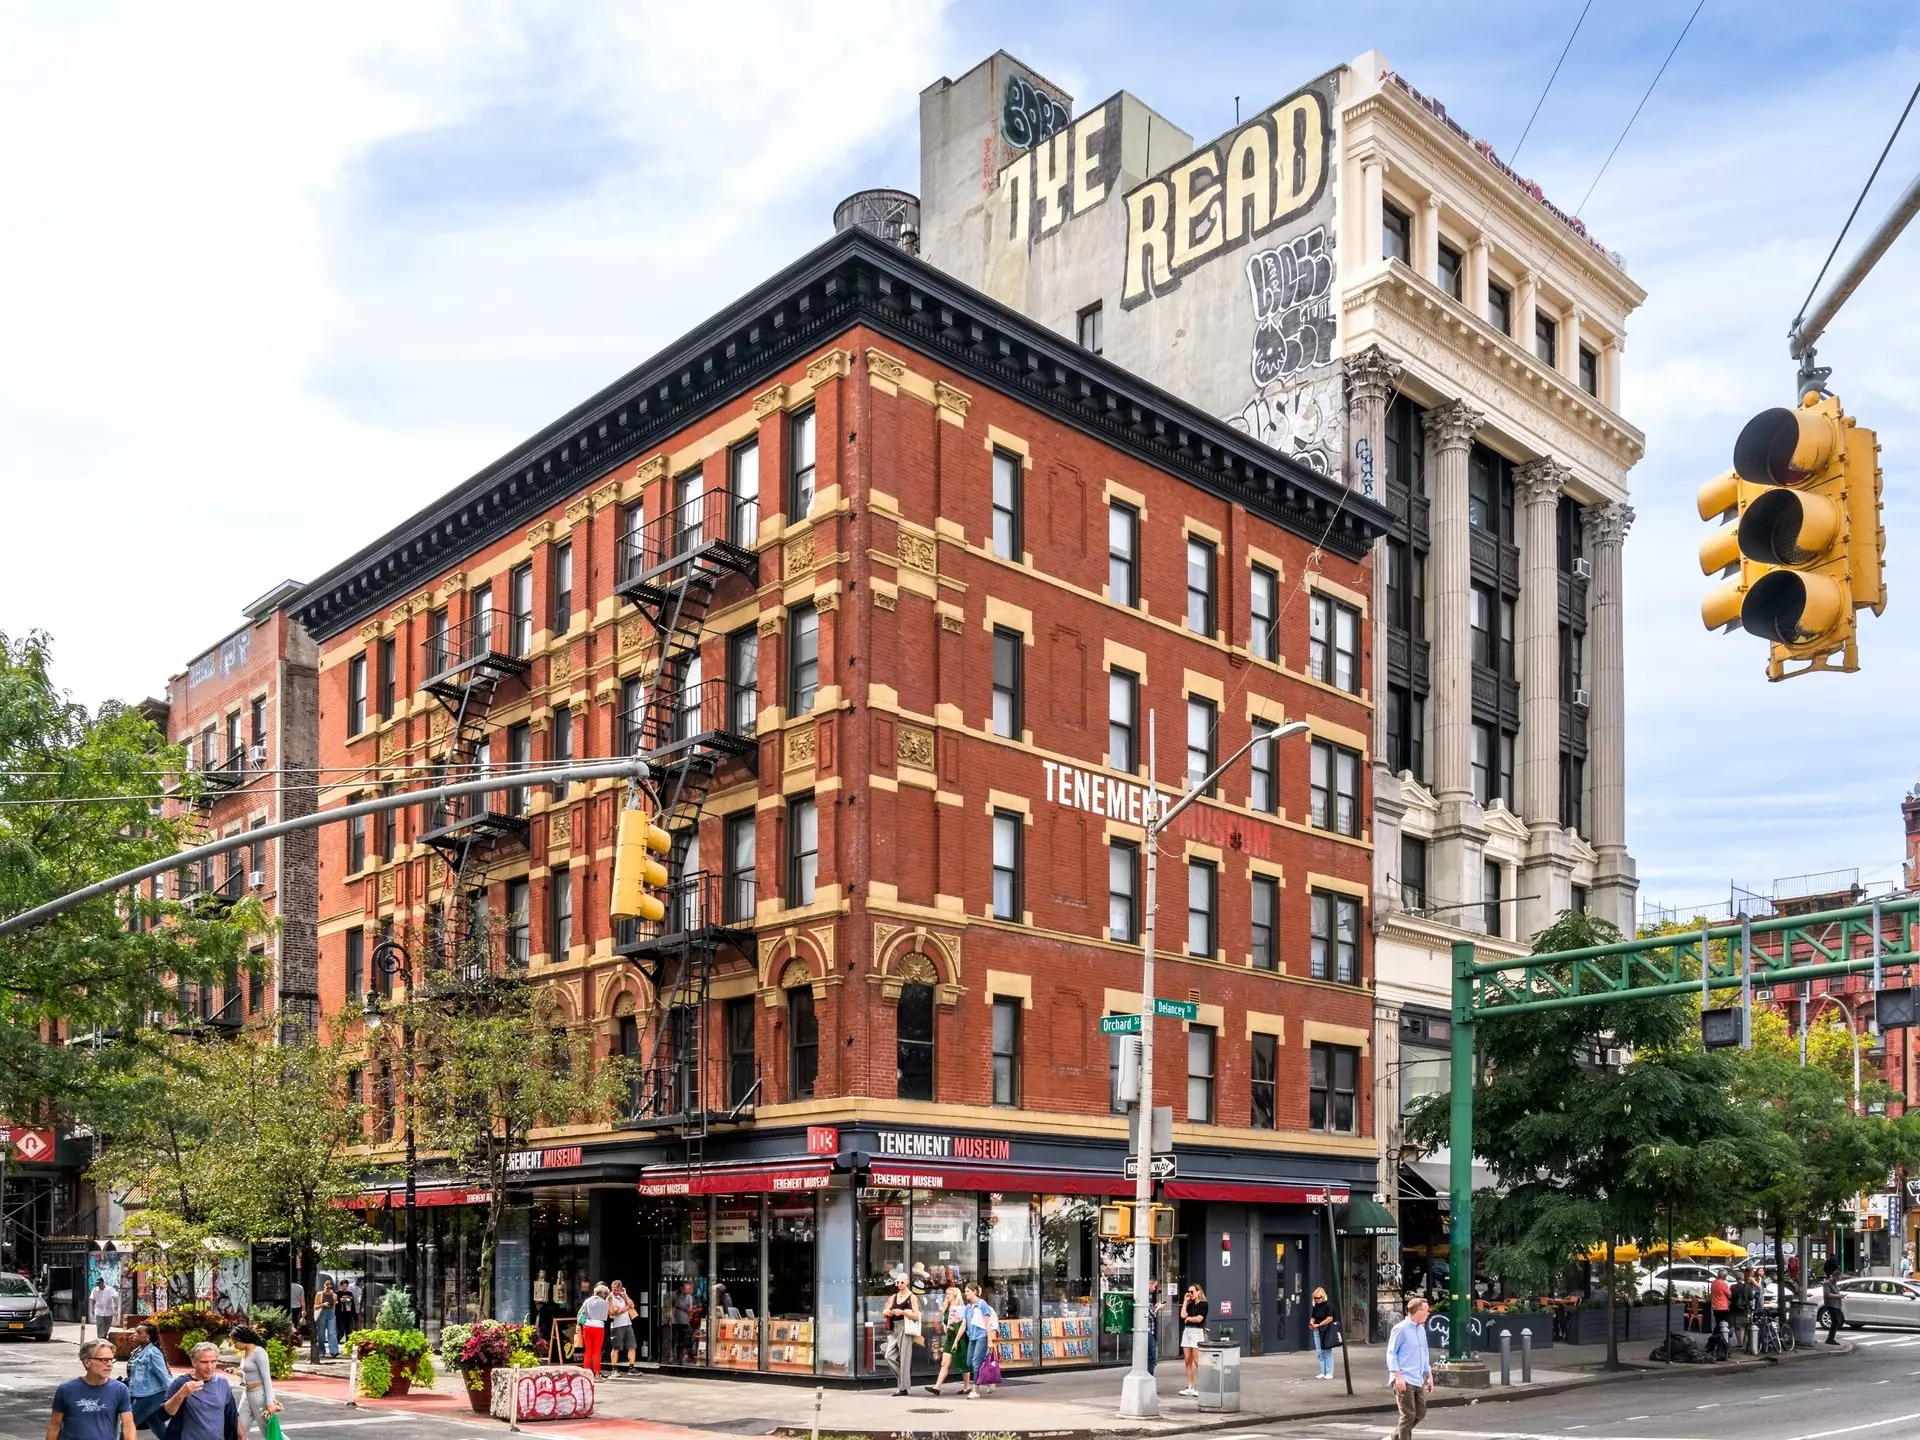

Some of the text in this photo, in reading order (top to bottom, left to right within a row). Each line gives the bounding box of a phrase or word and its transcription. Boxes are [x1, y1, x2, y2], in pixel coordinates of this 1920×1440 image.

[1158, 1001, 1192, 1018] Delancey St
[1103, 1018, 1132, 1032] Orchard
[878, 1132, 1010, 1160] TENEMENT MUSEUM
[544, 1147, 582, 1168] MUSEUM
[1153, 1163, 1170, 1171] WAY
[773, 1176, 830, 1190] TENEMENT MUSEUM
[873, 1173, 943, 1188] TENEMENT MUSEUM
[639, 1183, 690, 1195] TENEMENT MUSEUM
